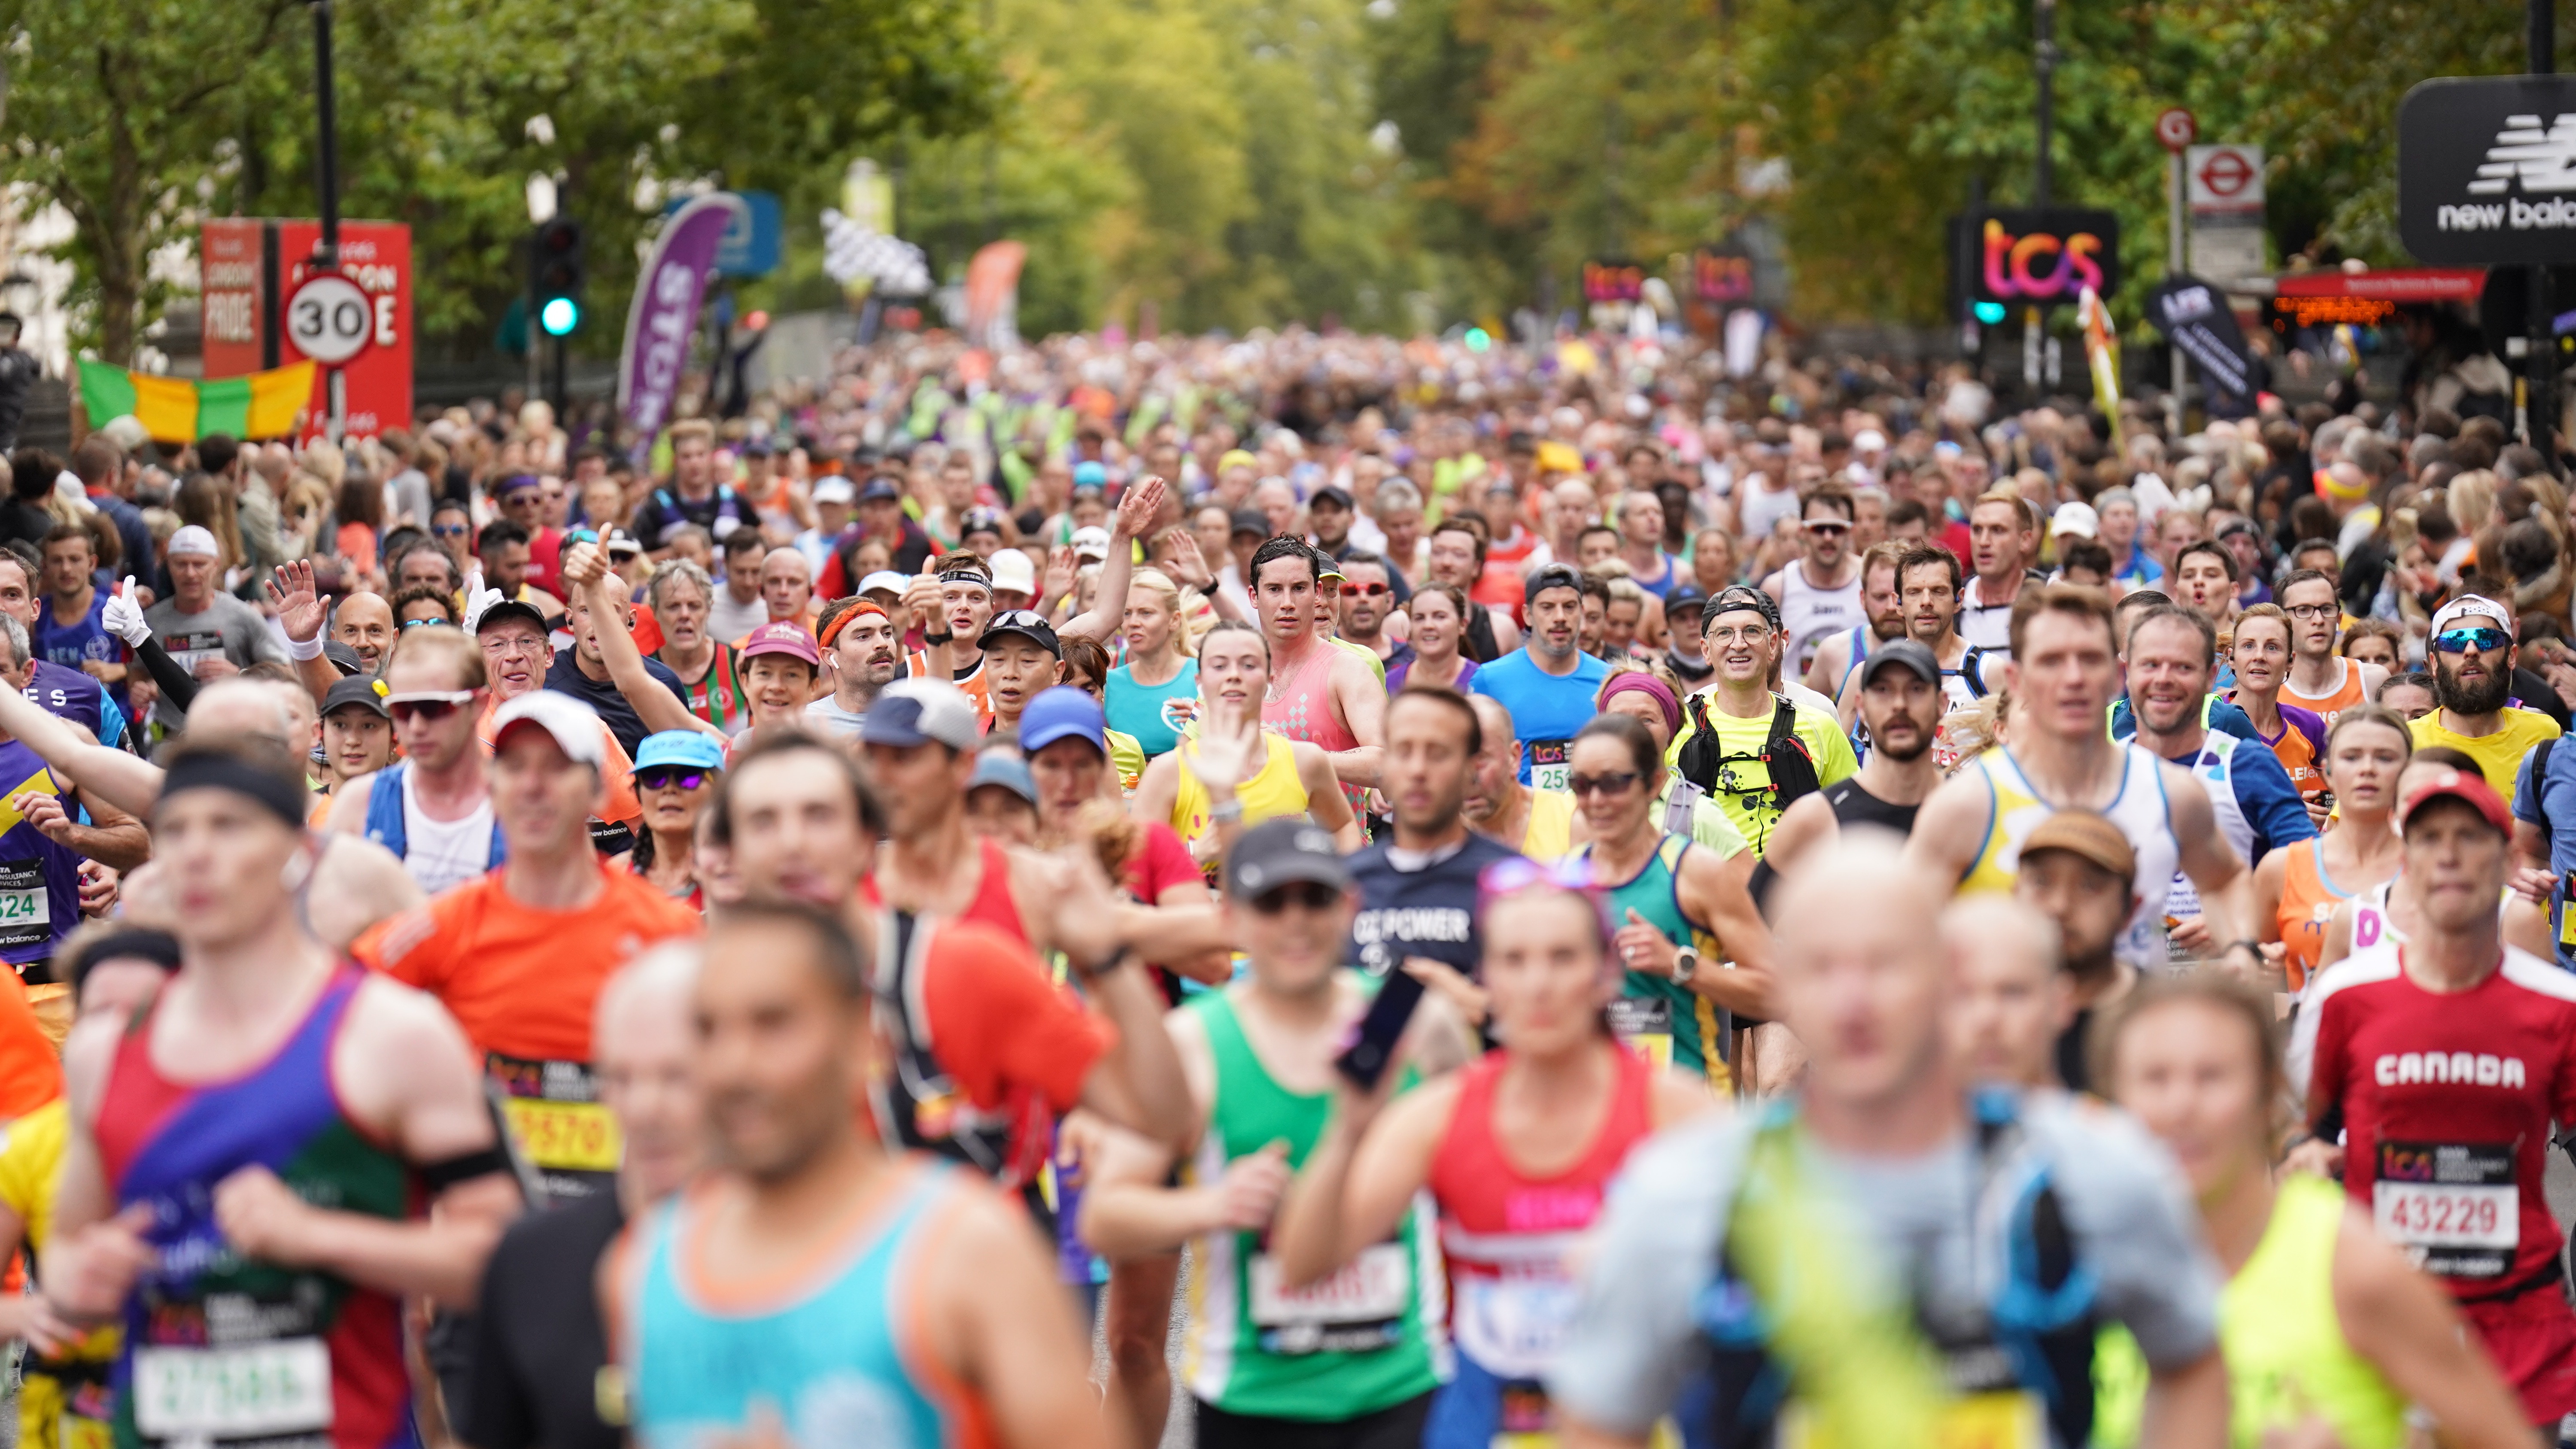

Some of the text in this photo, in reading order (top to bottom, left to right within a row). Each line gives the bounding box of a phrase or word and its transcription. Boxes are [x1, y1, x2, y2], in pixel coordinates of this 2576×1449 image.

[2437, 203, 2506, 232] new
[1983, 218, 2103, 298] tcs
[298, 300, 364, 339] 30
[1535, 745, 1563, 762] tcs
[603, 827, 627, 836] balance
[6, 935, 40, 943] balance
[2375, 1051, 2526, 1090] CANADA
[2390, 1194, 2498, 1234] 43229
